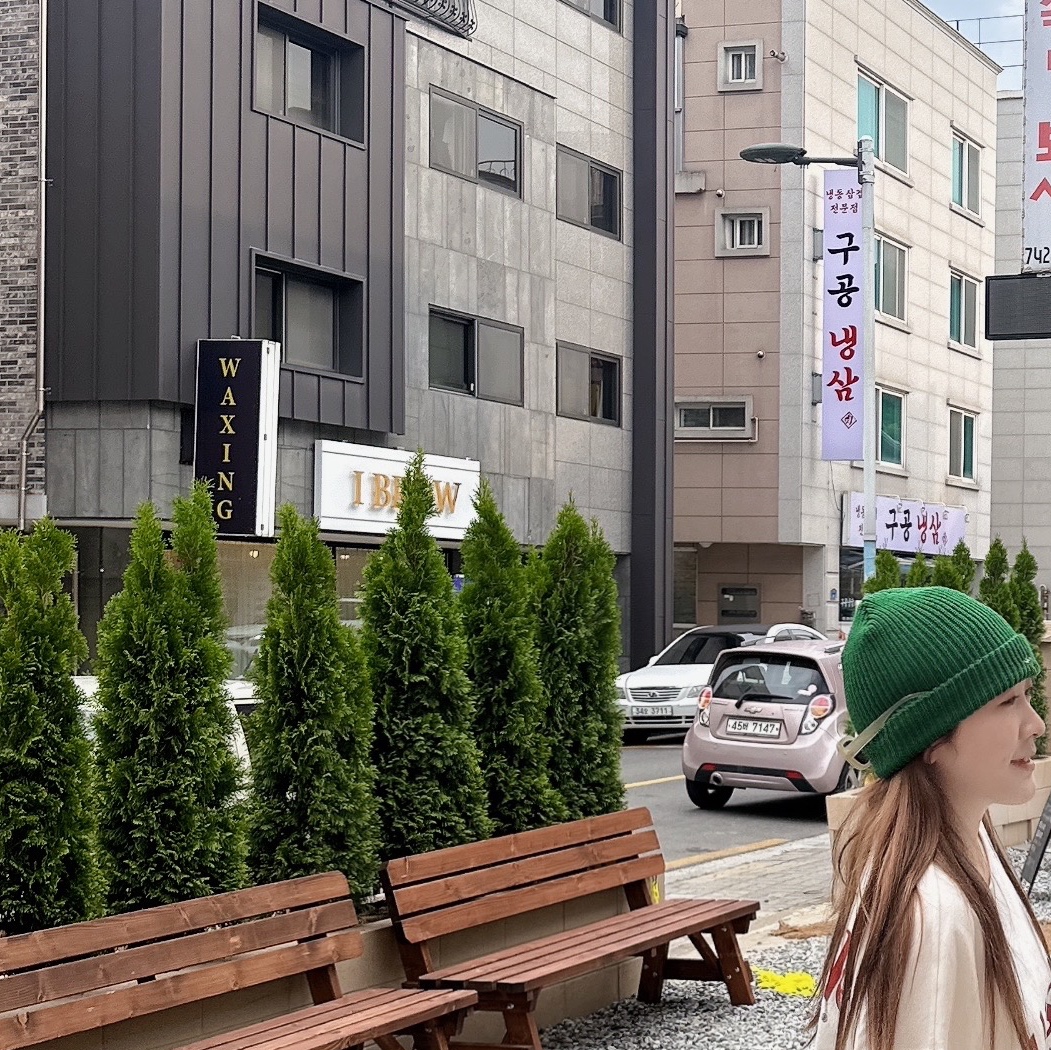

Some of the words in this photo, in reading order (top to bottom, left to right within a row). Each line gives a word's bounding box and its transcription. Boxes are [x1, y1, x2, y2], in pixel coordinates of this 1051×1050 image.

[830, 202, 858, 214] 전문점
[216, 357, 242, 520] WAXING
[752, 722, 775, 733] 7147
